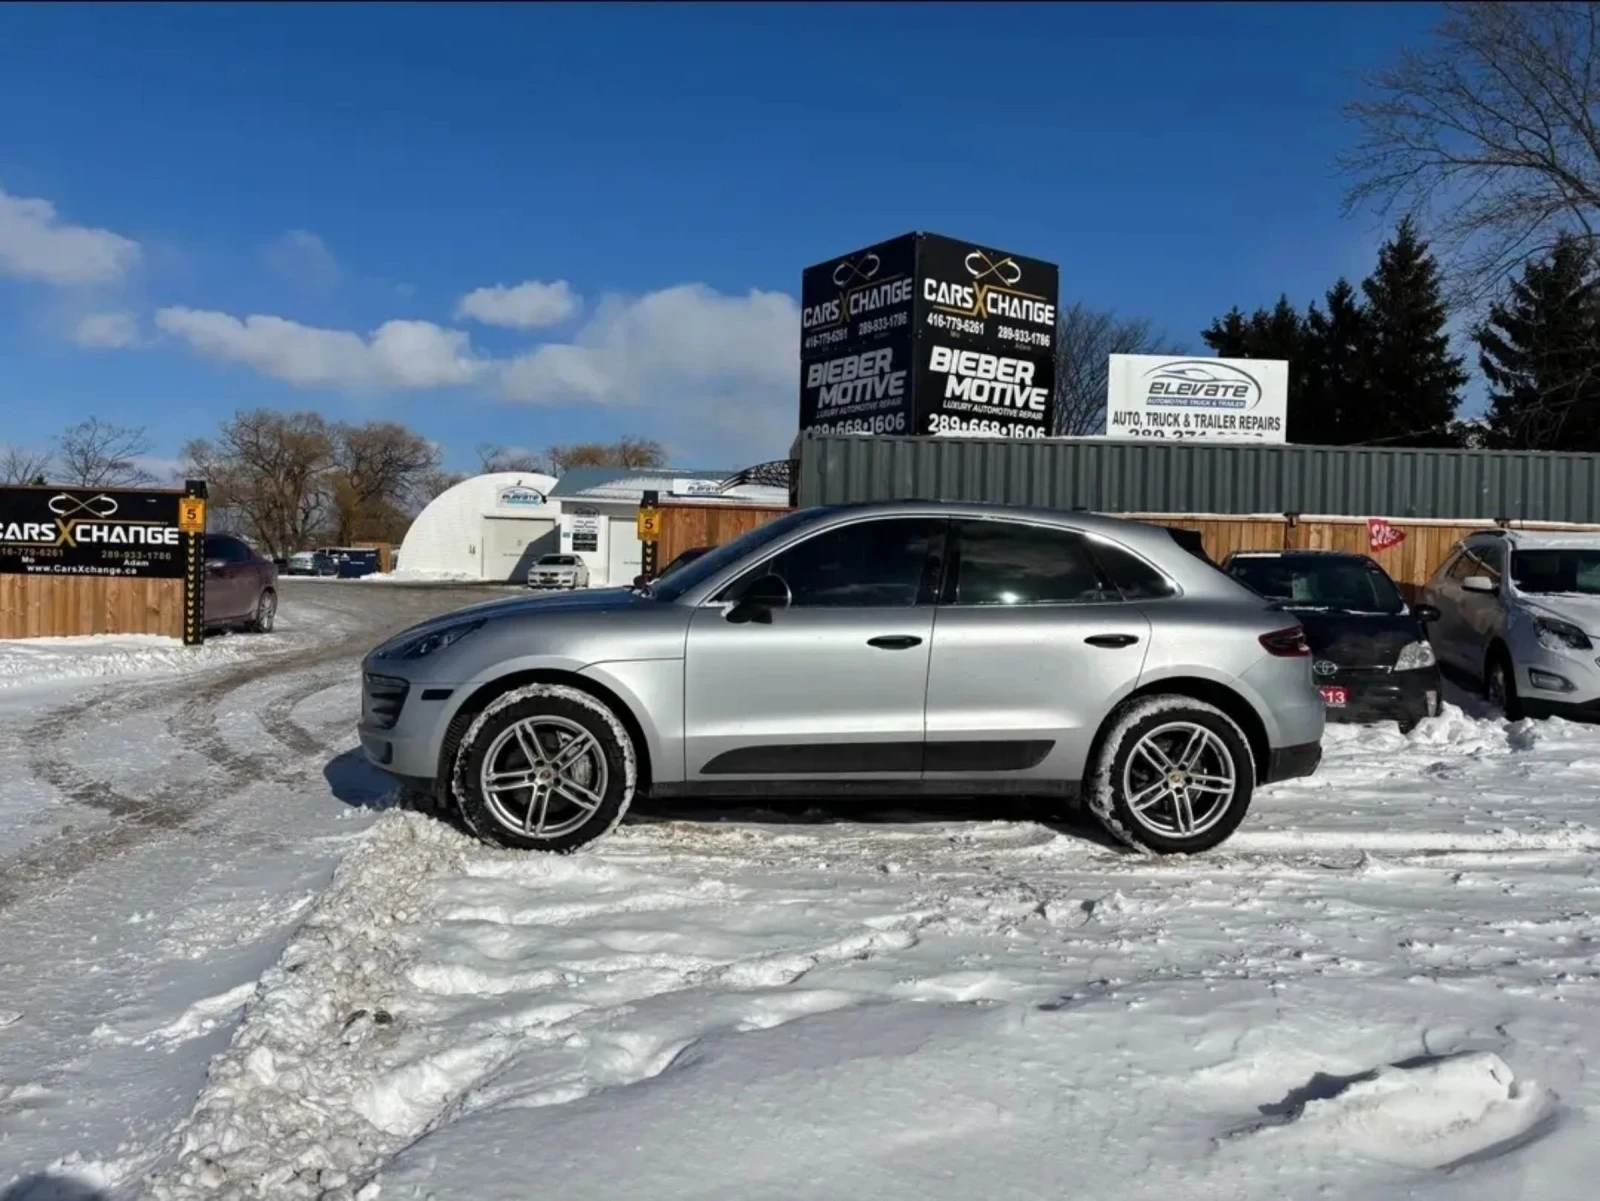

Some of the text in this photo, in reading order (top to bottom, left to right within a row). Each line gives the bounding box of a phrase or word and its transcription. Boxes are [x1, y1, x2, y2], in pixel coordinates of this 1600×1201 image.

[803, 278, 913, 329] CARSXCHANGE
[924, 278, 1055, 325] CARSXCHANGE
[927, 312, 1050, 347] 416-779-6261 289-933-1786
[807, 347, 893, 388] BIEBER
[929, 345, 1035, 386] BIEBER
[818, 370, 906, 409] MOTIVE
[944, 374, 1048, 411] MOTIVE
[943, 400, 1043, 420] LUXURY AUTOMOTIVE REPAIR
[1190, 399, 1210, 407] TRUCK
[1112, 411, 1281, 431] AUTO, TRUCK & TRAILER REPAIRS
[187, 508, 197, 520] 5
[644, 518, 654, 530] 5
[0, 548, 171, 561] 16-779-6261 289-933-1786
[21, 555, 149, 567] Mo Adam
[26, 564, 137, 576] www.CarsXchange.ca
[1319, 690, 1346, 704] 13
